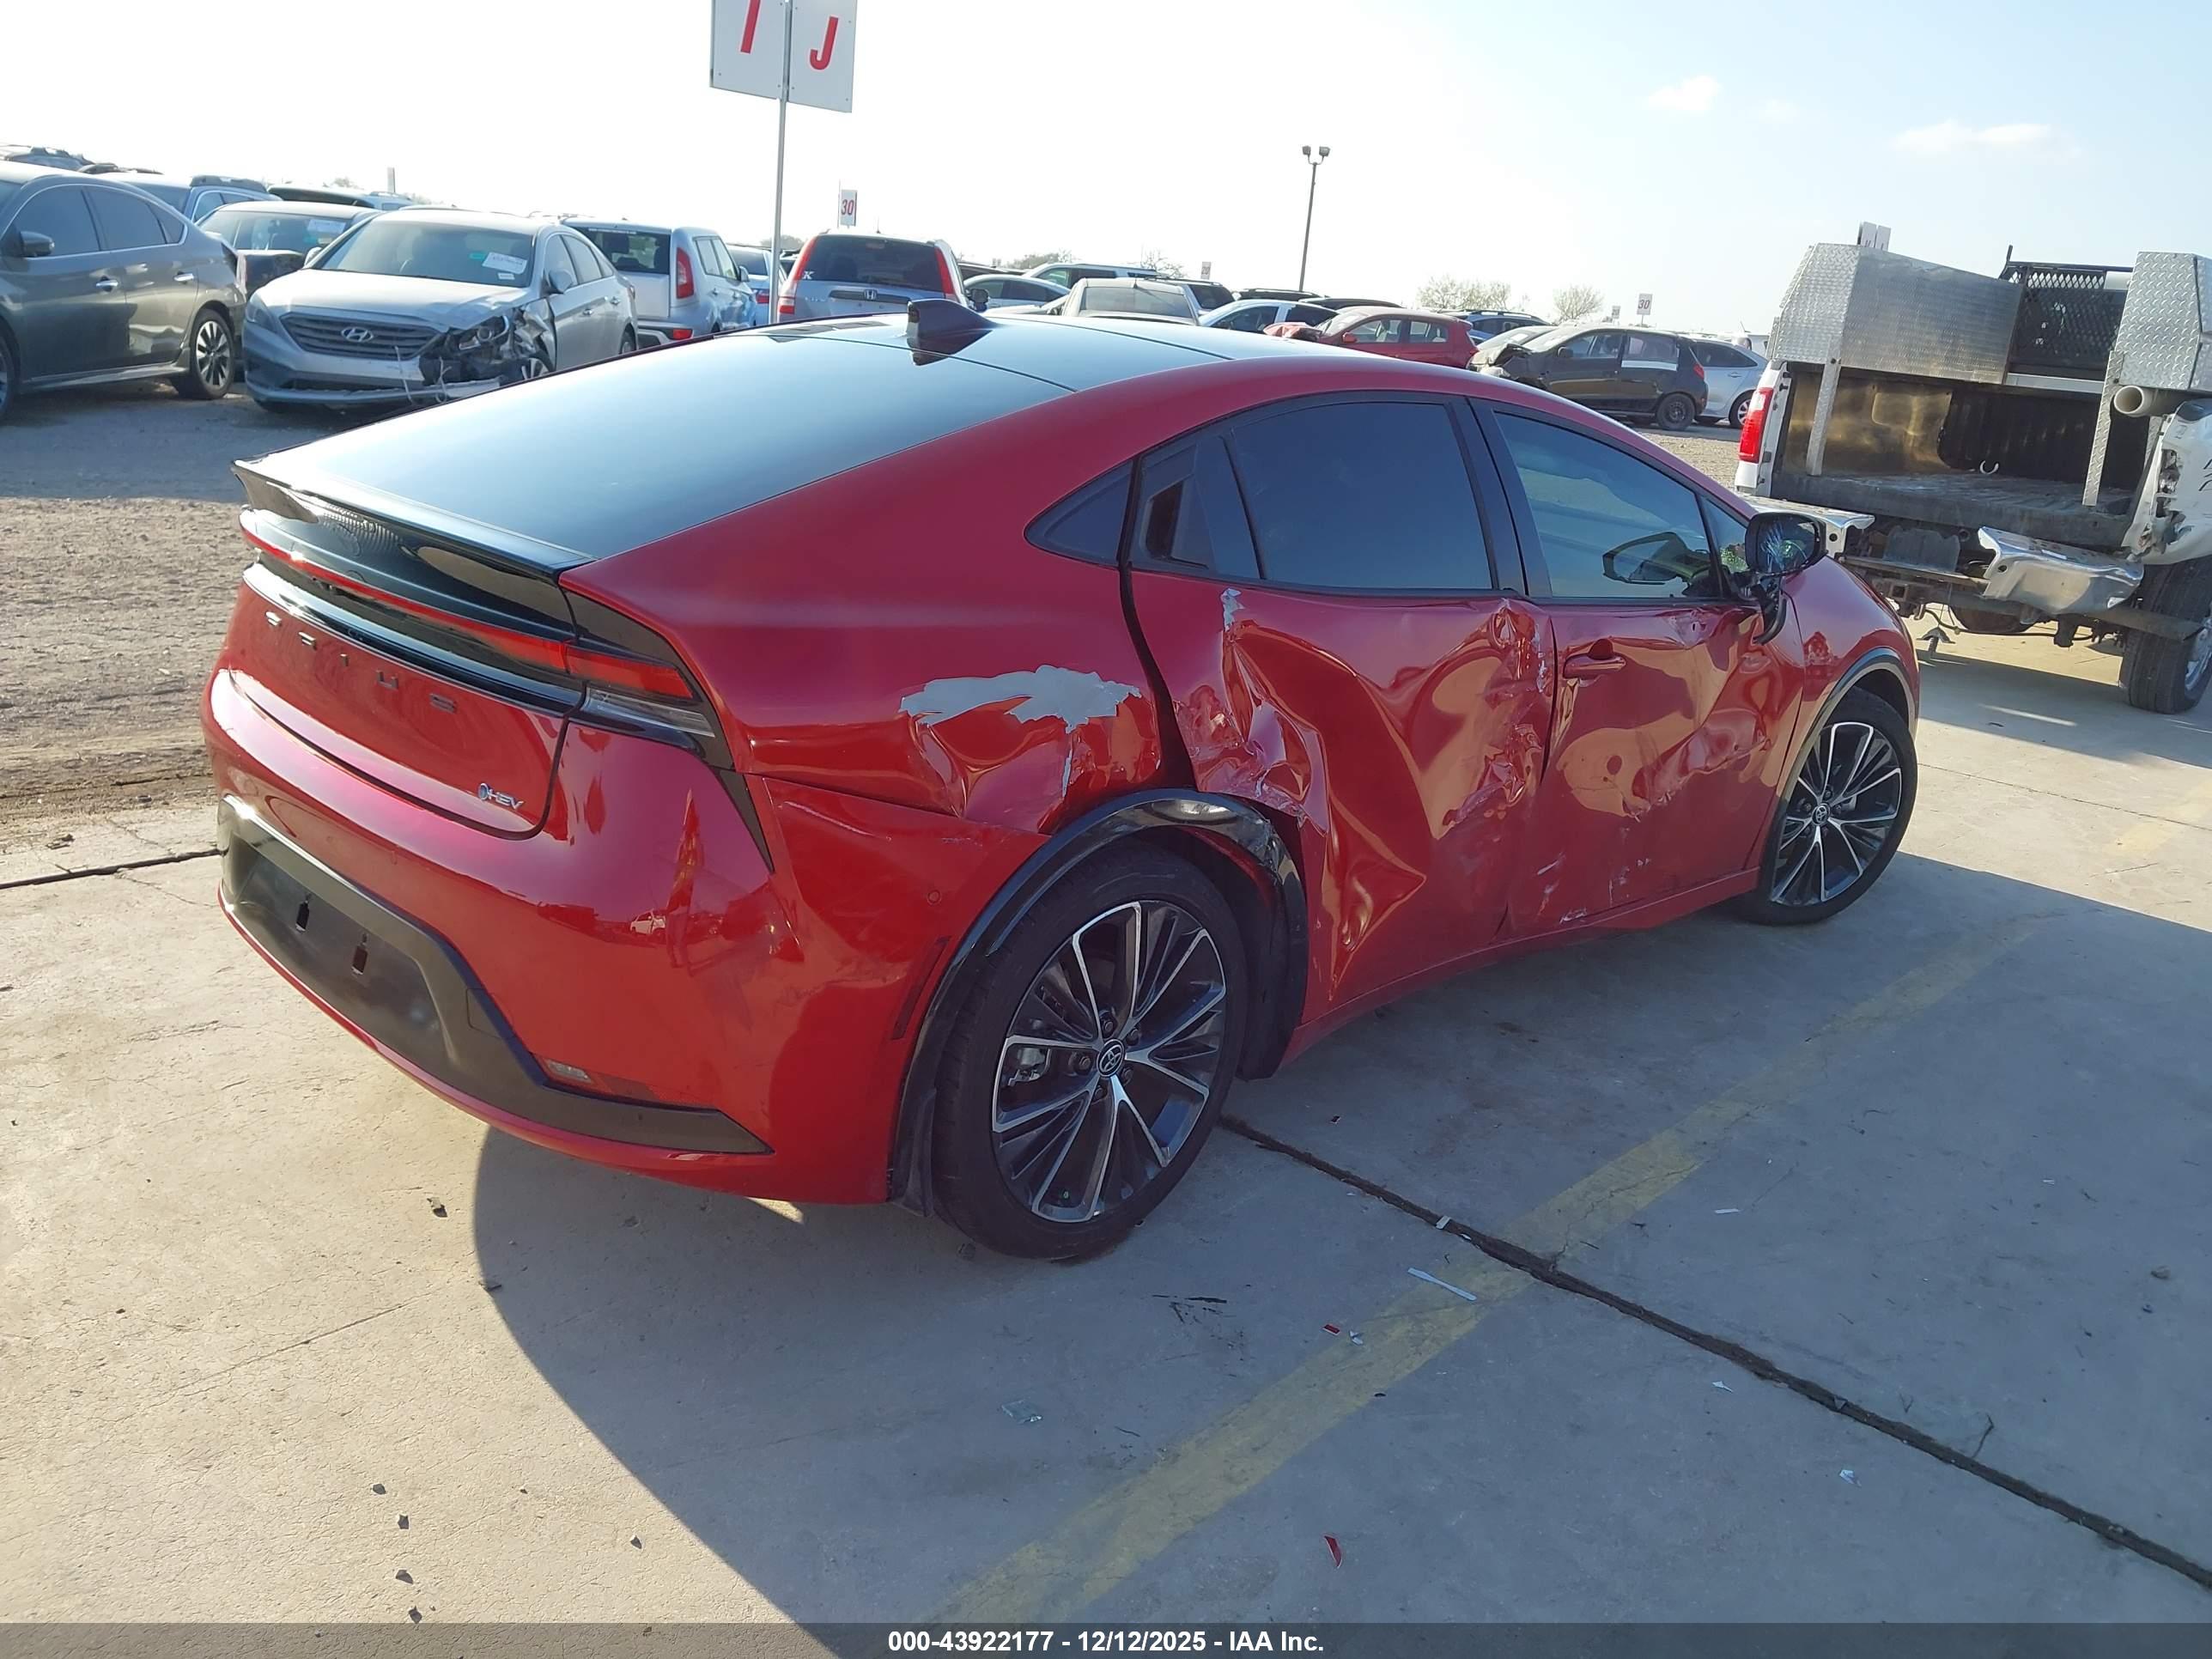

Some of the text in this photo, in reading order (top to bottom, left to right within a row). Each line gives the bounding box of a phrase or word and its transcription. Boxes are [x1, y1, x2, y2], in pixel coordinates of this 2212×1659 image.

[810, 15, 838, 70] J
[841, 198, 854, 216] 30
[1638, 299, 1650, 309] 30
